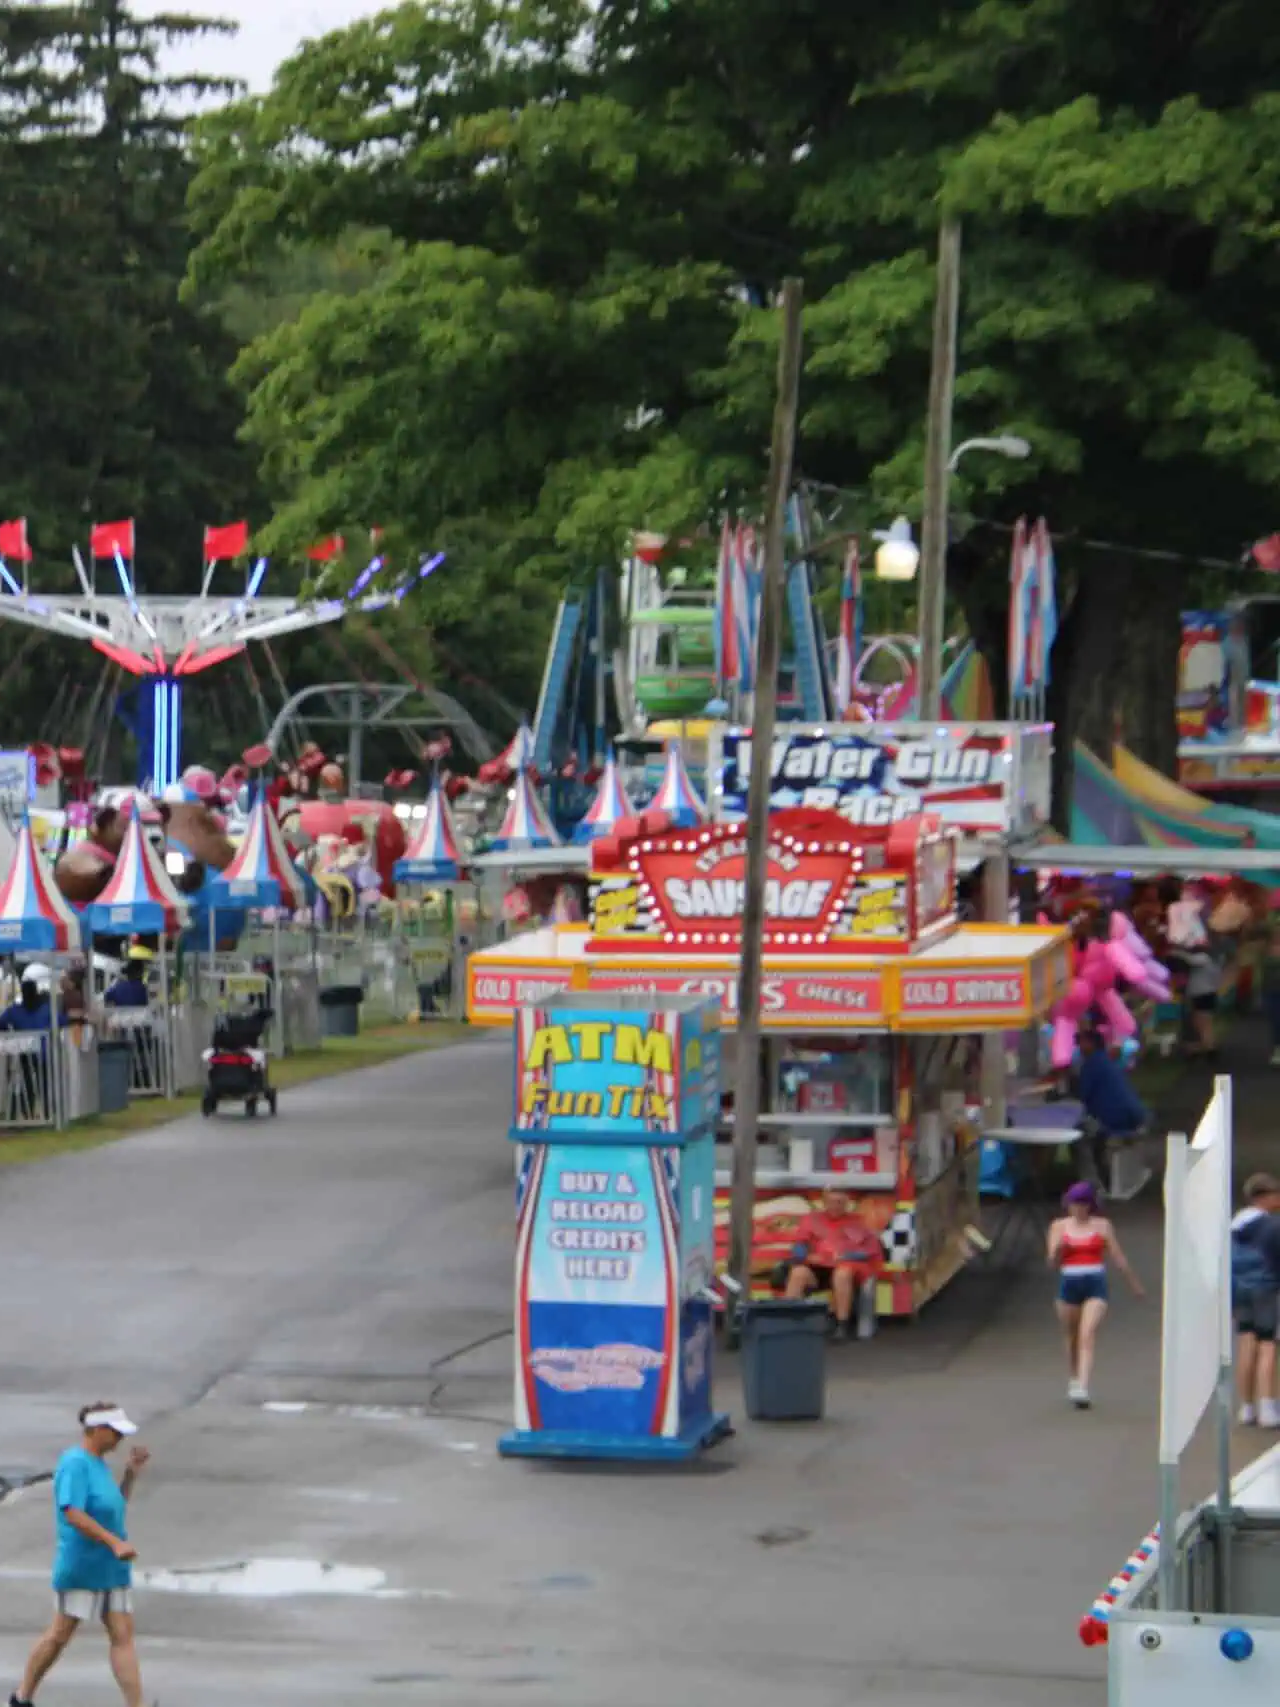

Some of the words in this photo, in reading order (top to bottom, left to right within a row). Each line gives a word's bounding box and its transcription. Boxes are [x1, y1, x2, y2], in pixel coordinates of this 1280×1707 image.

[736, 740, 882, 778] Water
[895, 740, 990, 779] Gun
[803, 787, 920, 825] Race
[696, 837, 800, 872] ITALAN
[475, 979, 511, 1001] COLD
[796, 982, 867, 1008] CHEESE
[904, 981, 947, 1004] COLD
[954, 979, 1021, 1004] DRINKS
[526, 1022, 672, 1074] ATM
[561, 1172, 609, 1194] BUY
[616, 1172, 637, 1194] &
[551, 1200, 646, 1221] RELOAD
[550, 1228, 645, 1252] CREDITS
[565, 1256, 628, 1280] HERE
